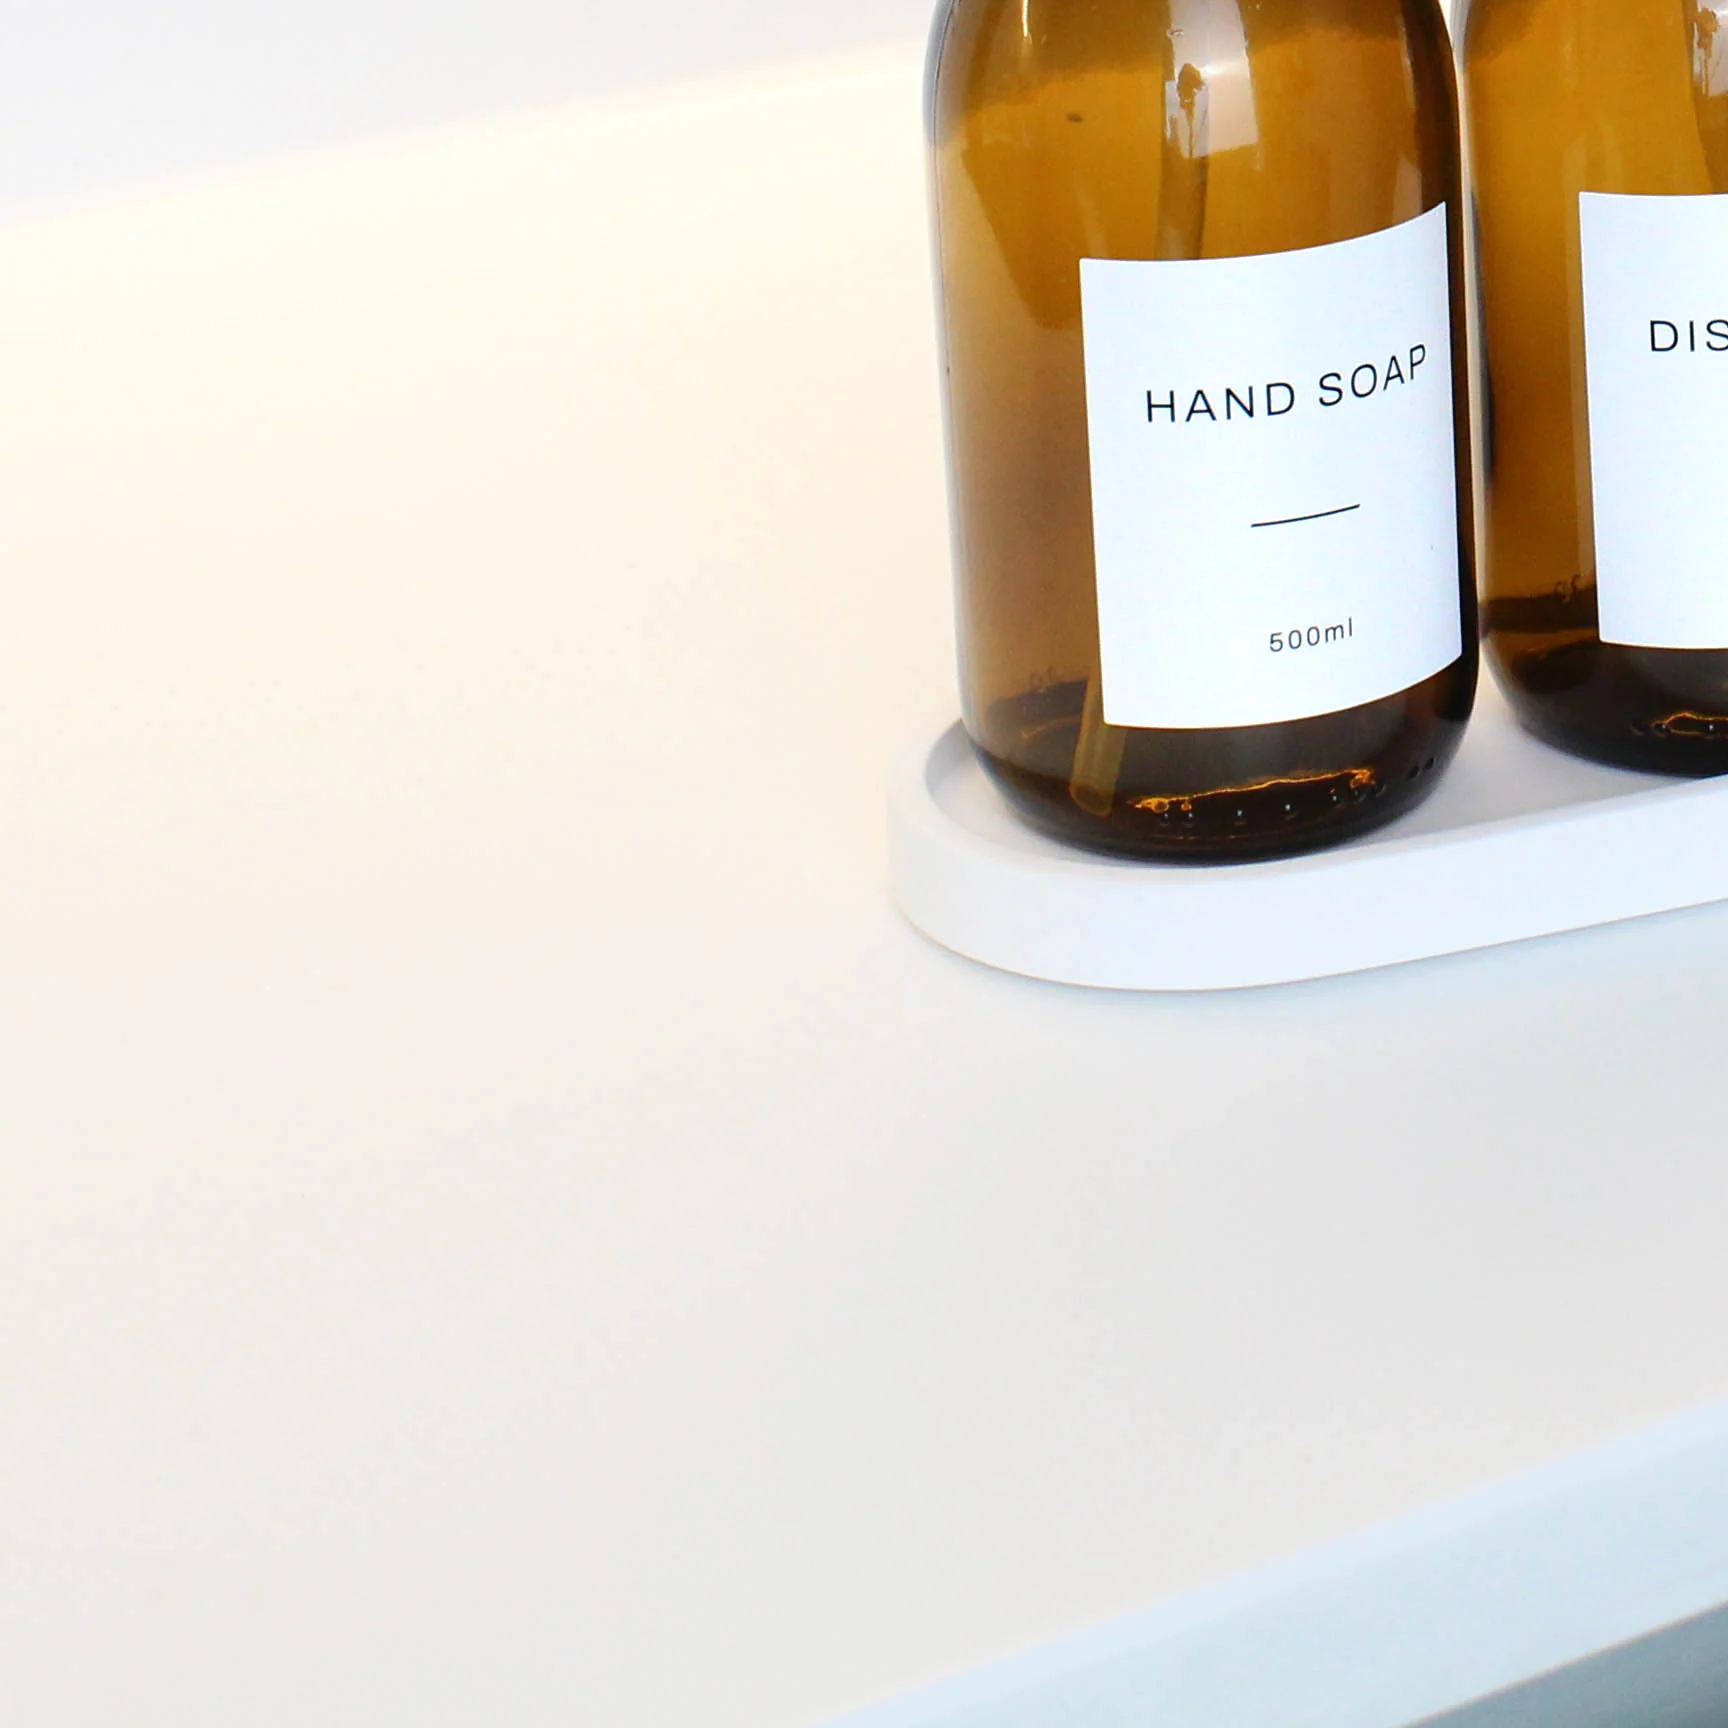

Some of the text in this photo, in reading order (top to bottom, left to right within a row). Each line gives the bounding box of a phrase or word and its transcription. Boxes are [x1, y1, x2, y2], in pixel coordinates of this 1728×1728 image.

[1146, 343, 1426, 423] HAND SOAP
[1270, 617, 1354, 652] 500ml
